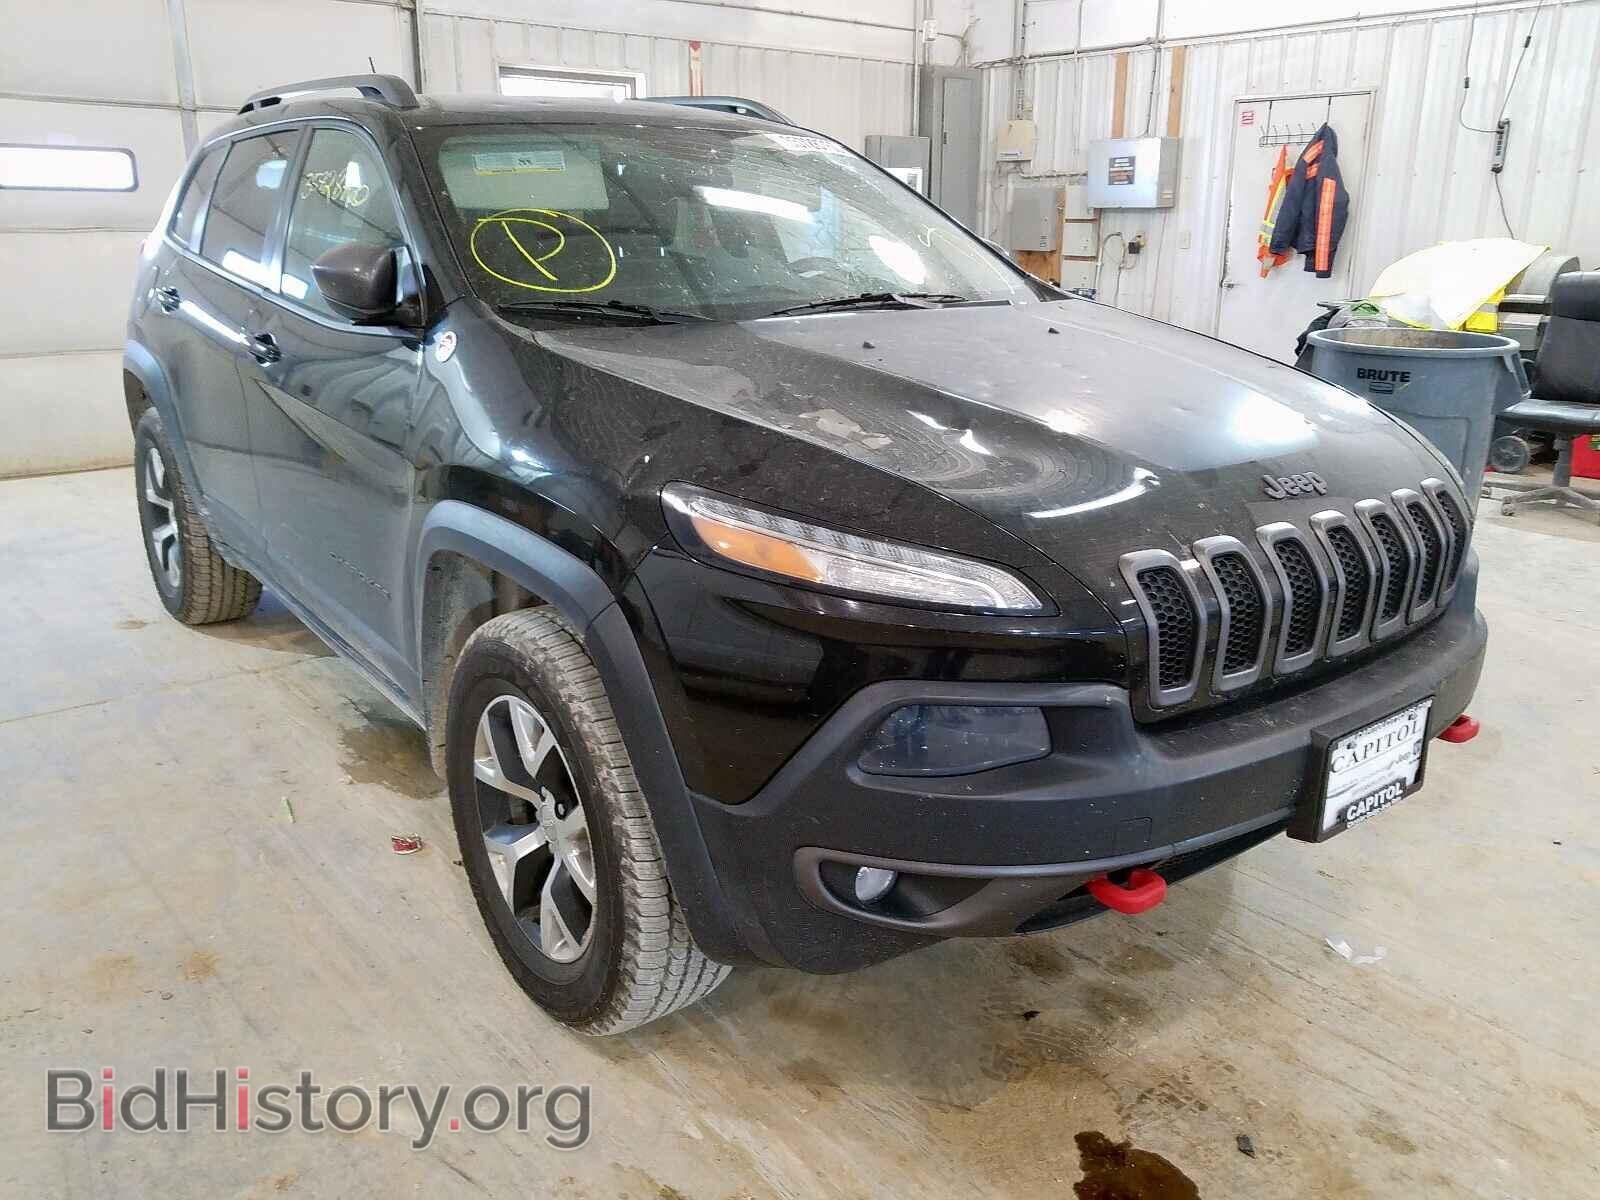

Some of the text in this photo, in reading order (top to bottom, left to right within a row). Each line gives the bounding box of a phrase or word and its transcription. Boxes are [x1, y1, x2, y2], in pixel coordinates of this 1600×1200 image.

[1356, 367, 1412, 383] BRUTE
[1262, 471, 1328, 500] Jeep
[1330, 721, 1418, 774] CAPITOL
[1346, 782, 1404, 821] CAPITOL
